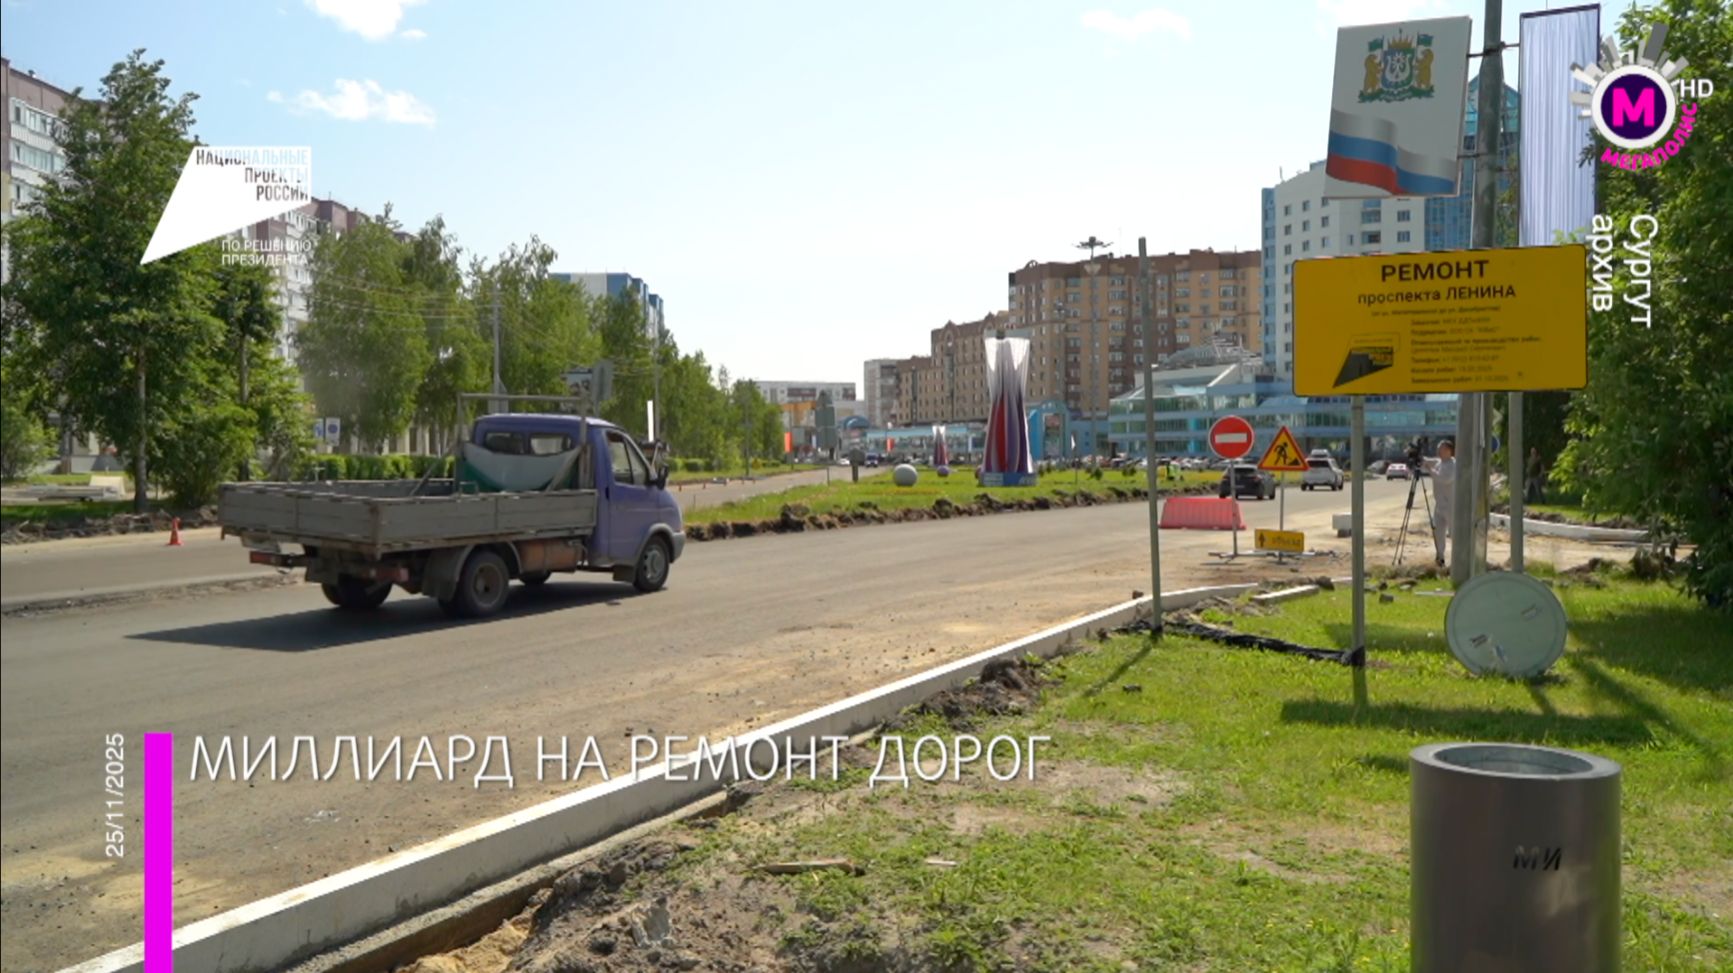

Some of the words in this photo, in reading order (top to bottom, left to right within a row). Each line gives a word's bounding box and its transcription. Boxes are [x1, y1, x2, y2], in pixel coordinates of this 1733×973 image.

[1381, 260, 1489, 282] РЕМОНТ
[1358, 289, 1441, 307] проспекта
[1446, 285, 1516, 300] ЛЕНИНА
